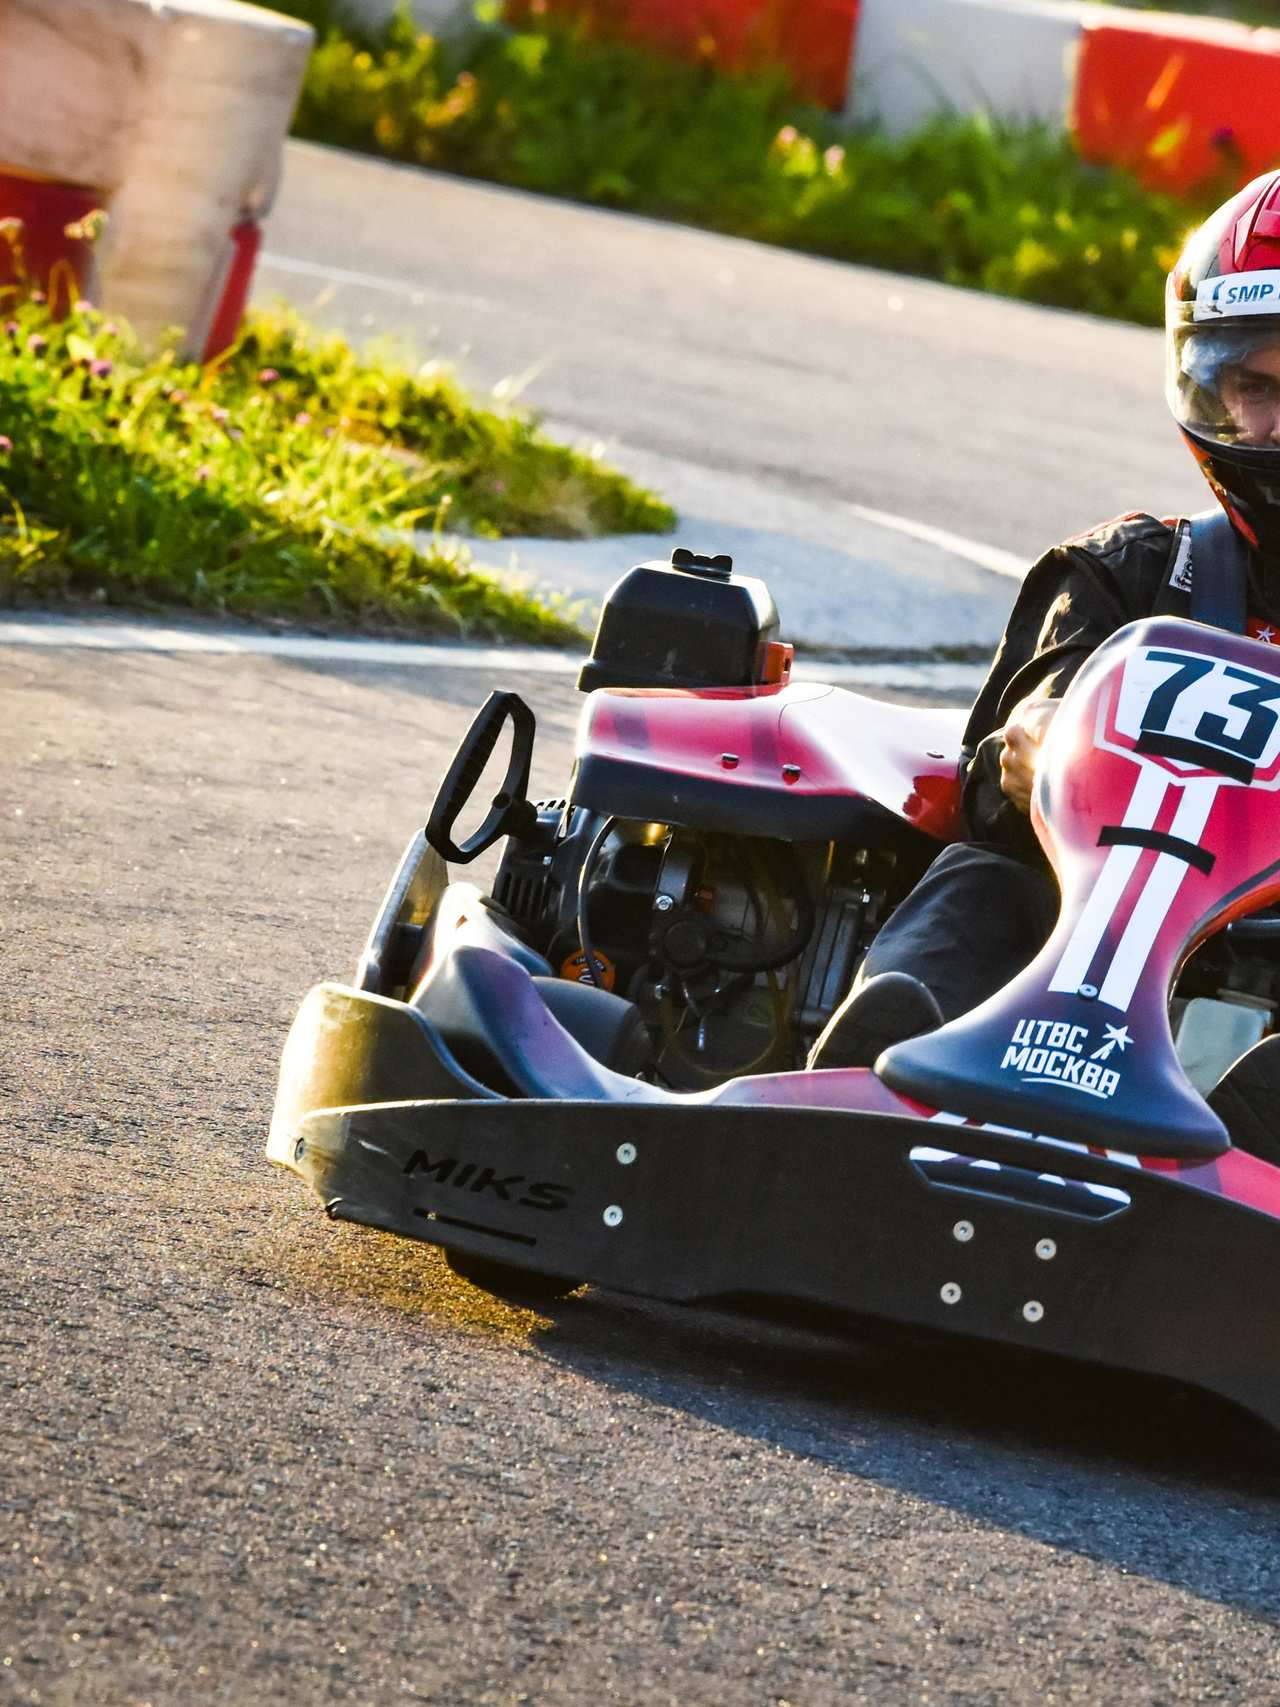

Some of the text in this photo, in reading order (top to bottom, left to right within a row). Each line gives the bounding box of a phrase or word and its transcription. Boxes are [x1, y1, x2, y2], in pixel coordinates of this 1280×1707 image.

[1225, 283, 1274, 304] SMP
[1011, 1019, 1090, 1054] ЦТВС
[1000, 1045, 1121, 1096] МОСКВА
[402, 1149, 577, 1212] MIKS
